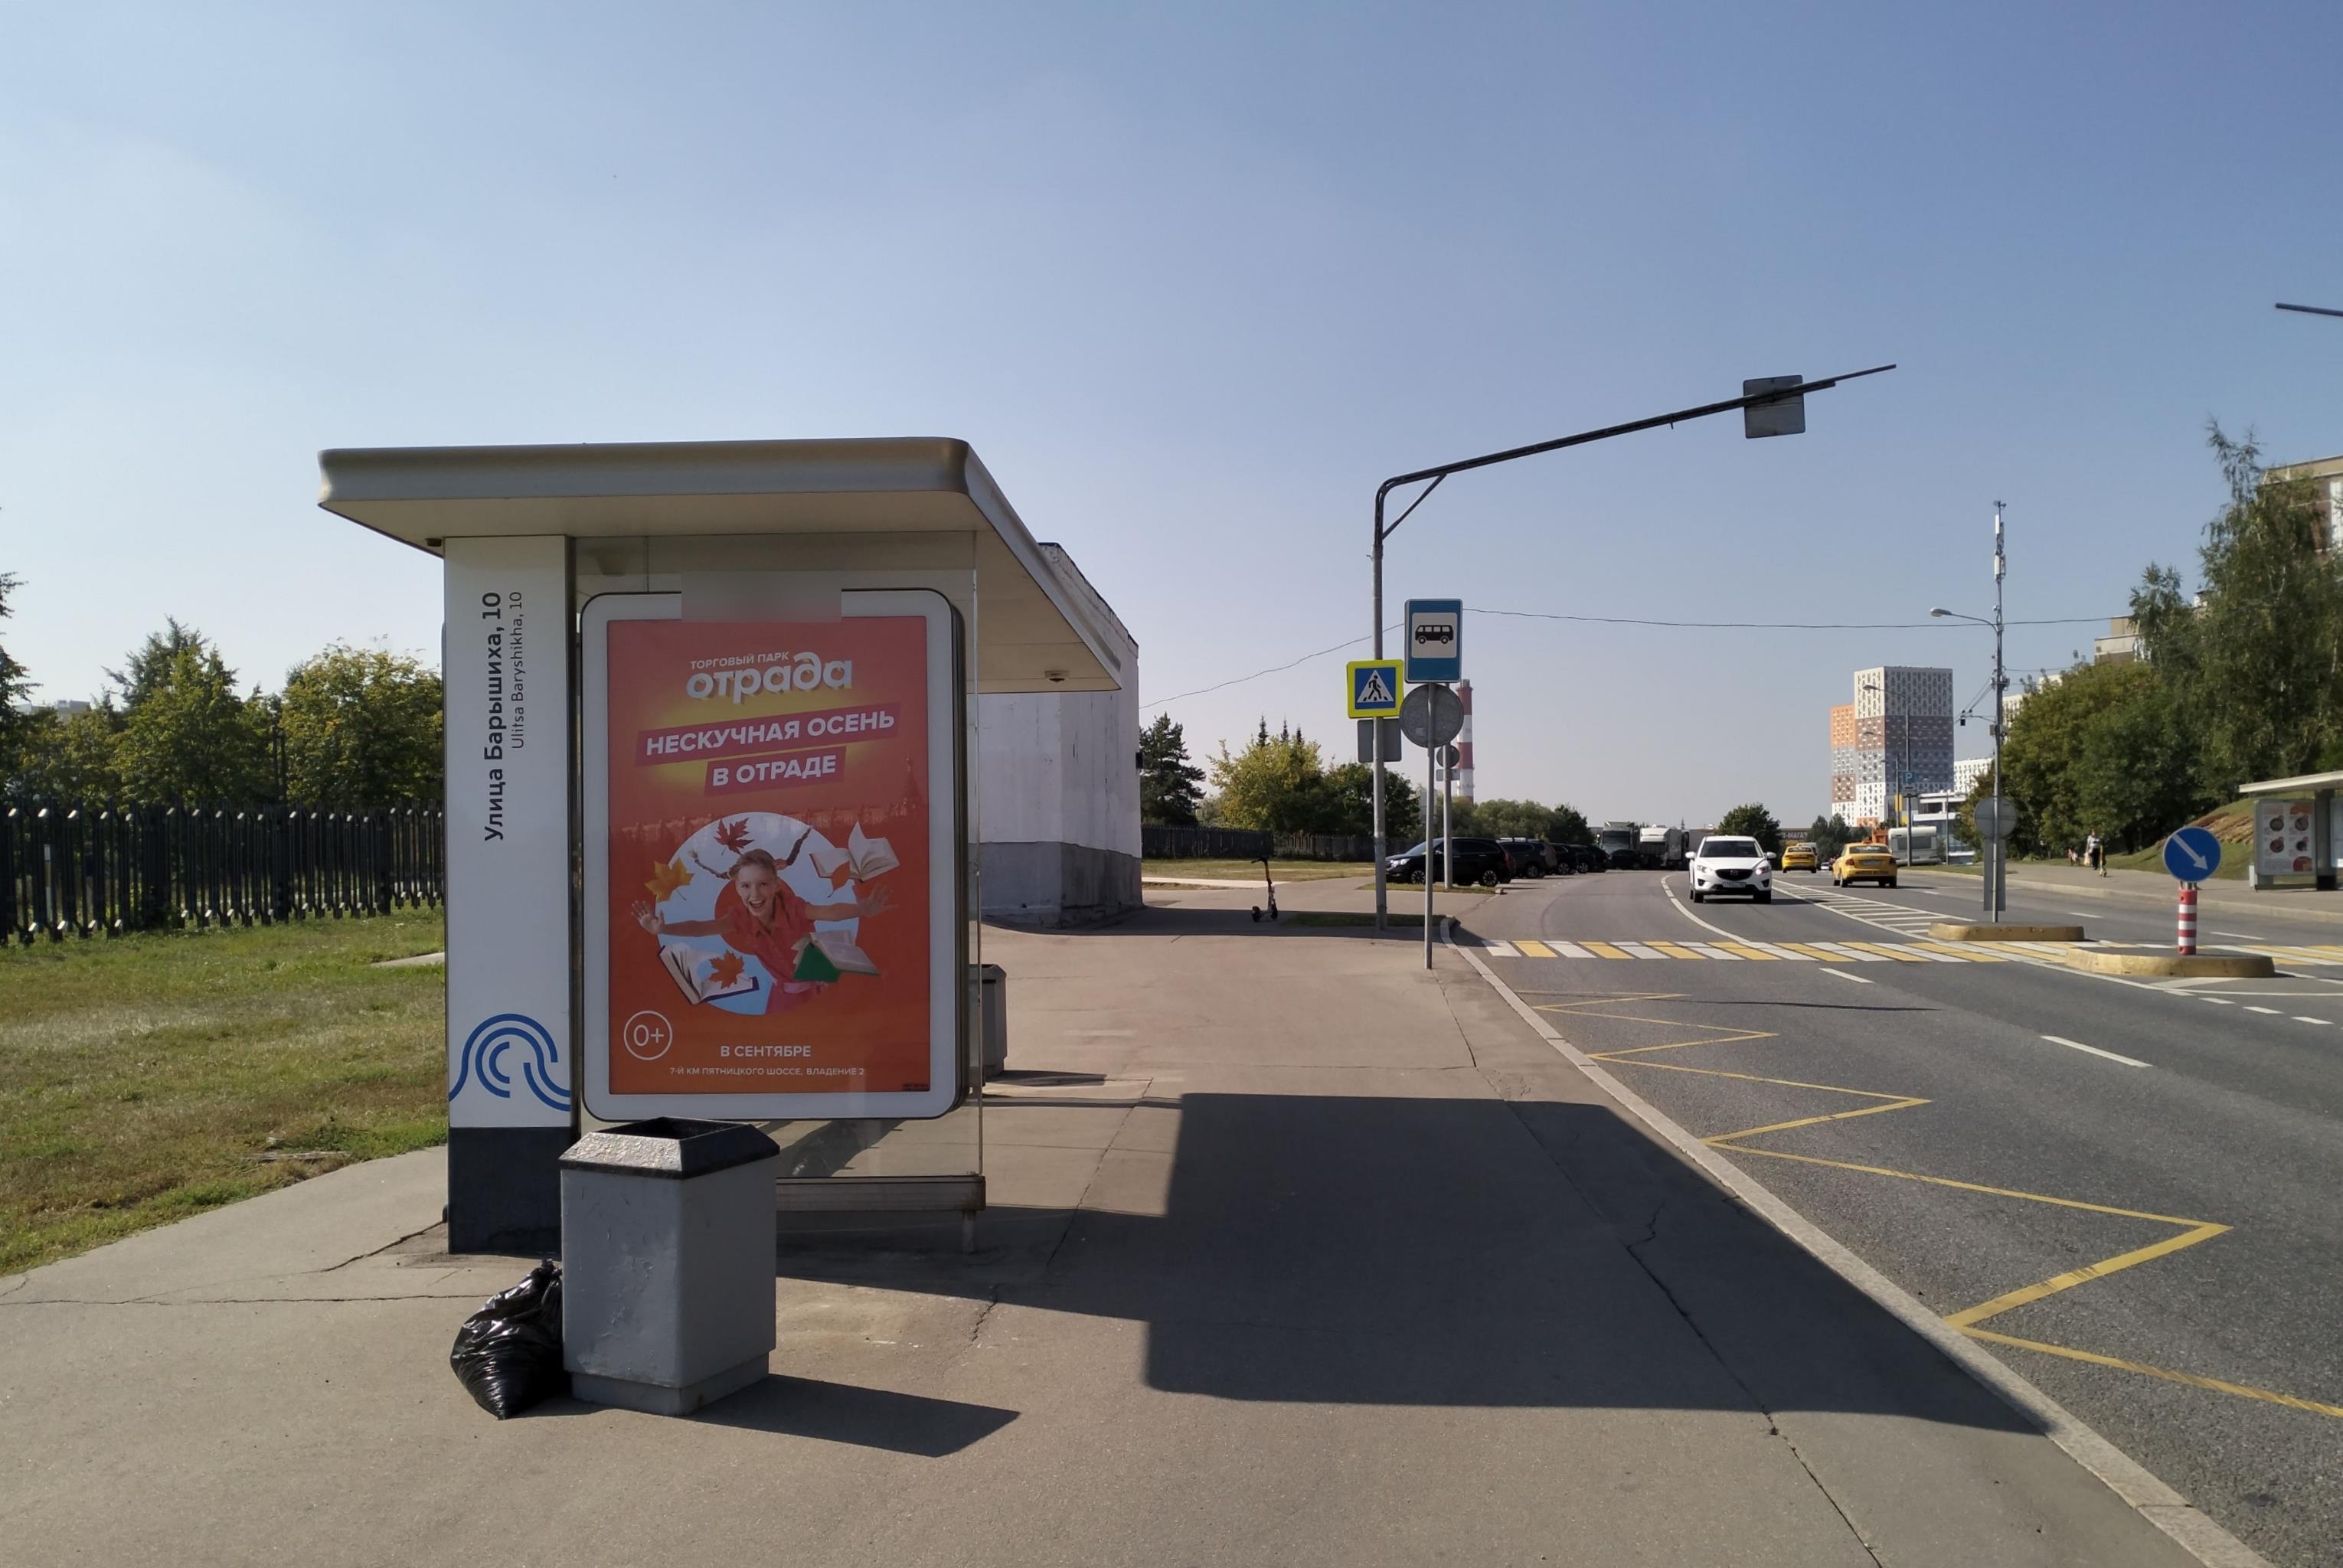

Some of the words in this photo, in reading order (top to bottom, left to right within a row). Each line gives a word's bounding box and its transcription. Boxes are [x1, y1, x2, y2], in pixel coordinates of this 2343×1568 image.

[482, 592, 502, 620] 10
[509, 591, 522, 610] 10
[510, 613, 526, 702] Baryshikha,
[691, 652, 755, 669] ТОРГОВЫЙ
[757, 651, 789, 664] ПАРК
[484, 626, 506, 760] Барышиха,
[686, 651, 853, 704] отрада
[511, 706, 524, 749] Ulitsa
[646, 720, 799, 756] НЕСКУЧНАЯ
[807, 710, 894, 737] ОСЕНЬ
[712, 767, 729, 787] В
[736, 755, 836, 783] ОТРАДЕ
[484, 768, 506, 841] Улица
[632, 1024, 665, 1047] 0+
[720, 1046, 730, 1057] В
[734, 1045, 812, 1057] СЕНТЯБРЕ
[702, 1067, 764, 1076] ПЯТНИЦКОГО
[806, 1067, 855, 1076] ВЛАДЕНИЕ
